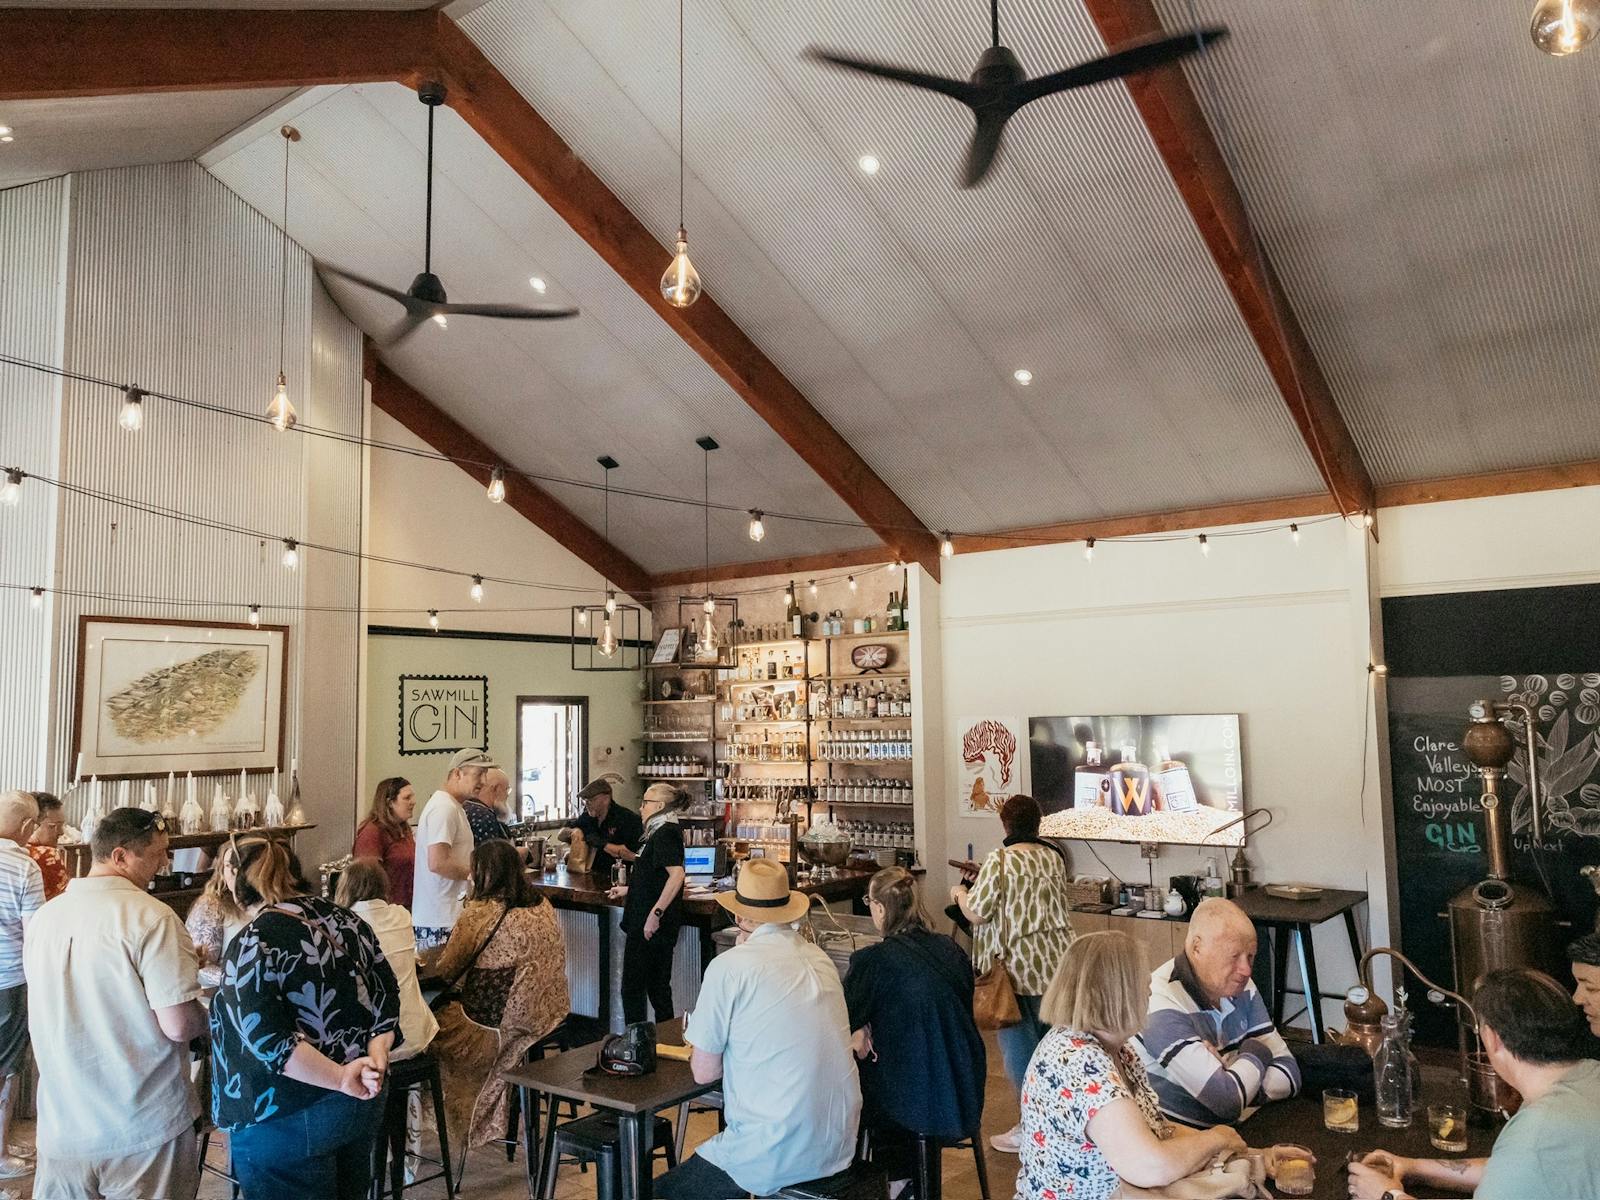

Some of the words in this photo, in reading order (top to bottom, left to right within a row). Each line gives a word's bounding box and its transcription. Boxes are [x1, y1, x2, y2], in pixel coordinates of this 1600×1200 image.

[411, 689, 480, 702] SAWMILL
[409, 704, 478, 743] GIN
[1413, 736, 1459, 752] Clare
[1417, 776, 1465, 793] MOST
[1413, 795, 1482, 820] Enjoyable
[1425, 822, 1476, 847] GIN
